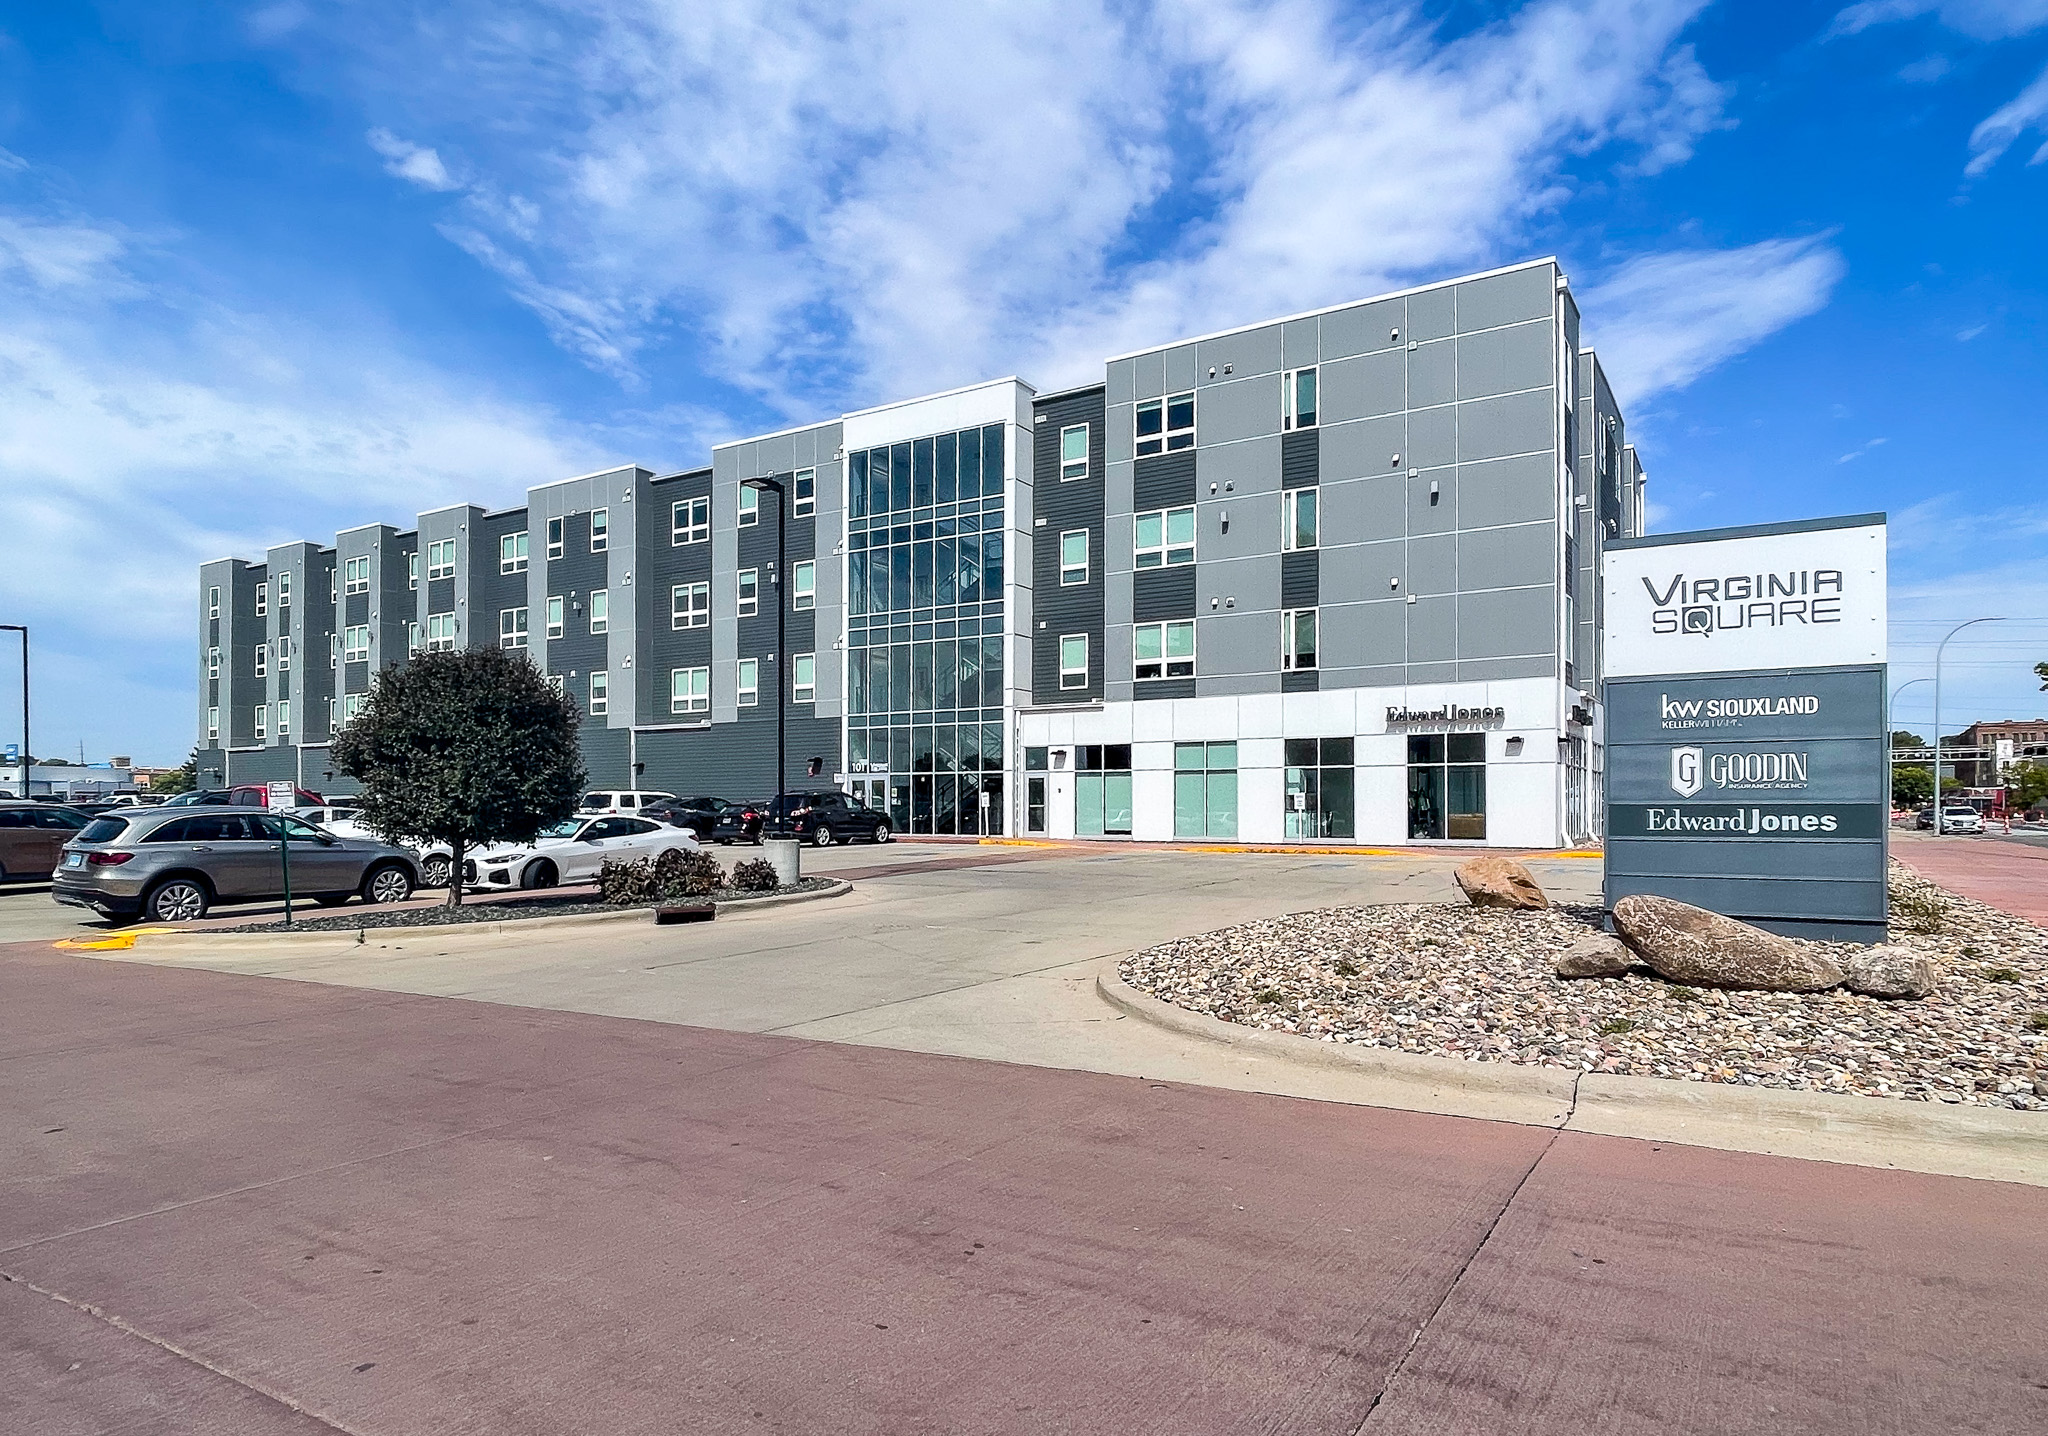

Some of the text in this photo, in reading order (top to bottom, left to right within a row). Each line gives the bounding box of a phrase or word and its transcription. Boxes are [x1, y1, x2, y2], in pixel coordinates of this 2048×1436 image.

[1641, 570, 1843, 606] VIRGINIA
[1652, 597, 1841, 638] SQUARE
[1661, 693, 1819, 718] kw SIOUXLAND
[1710, 752, 1808, 789] GOODIN
